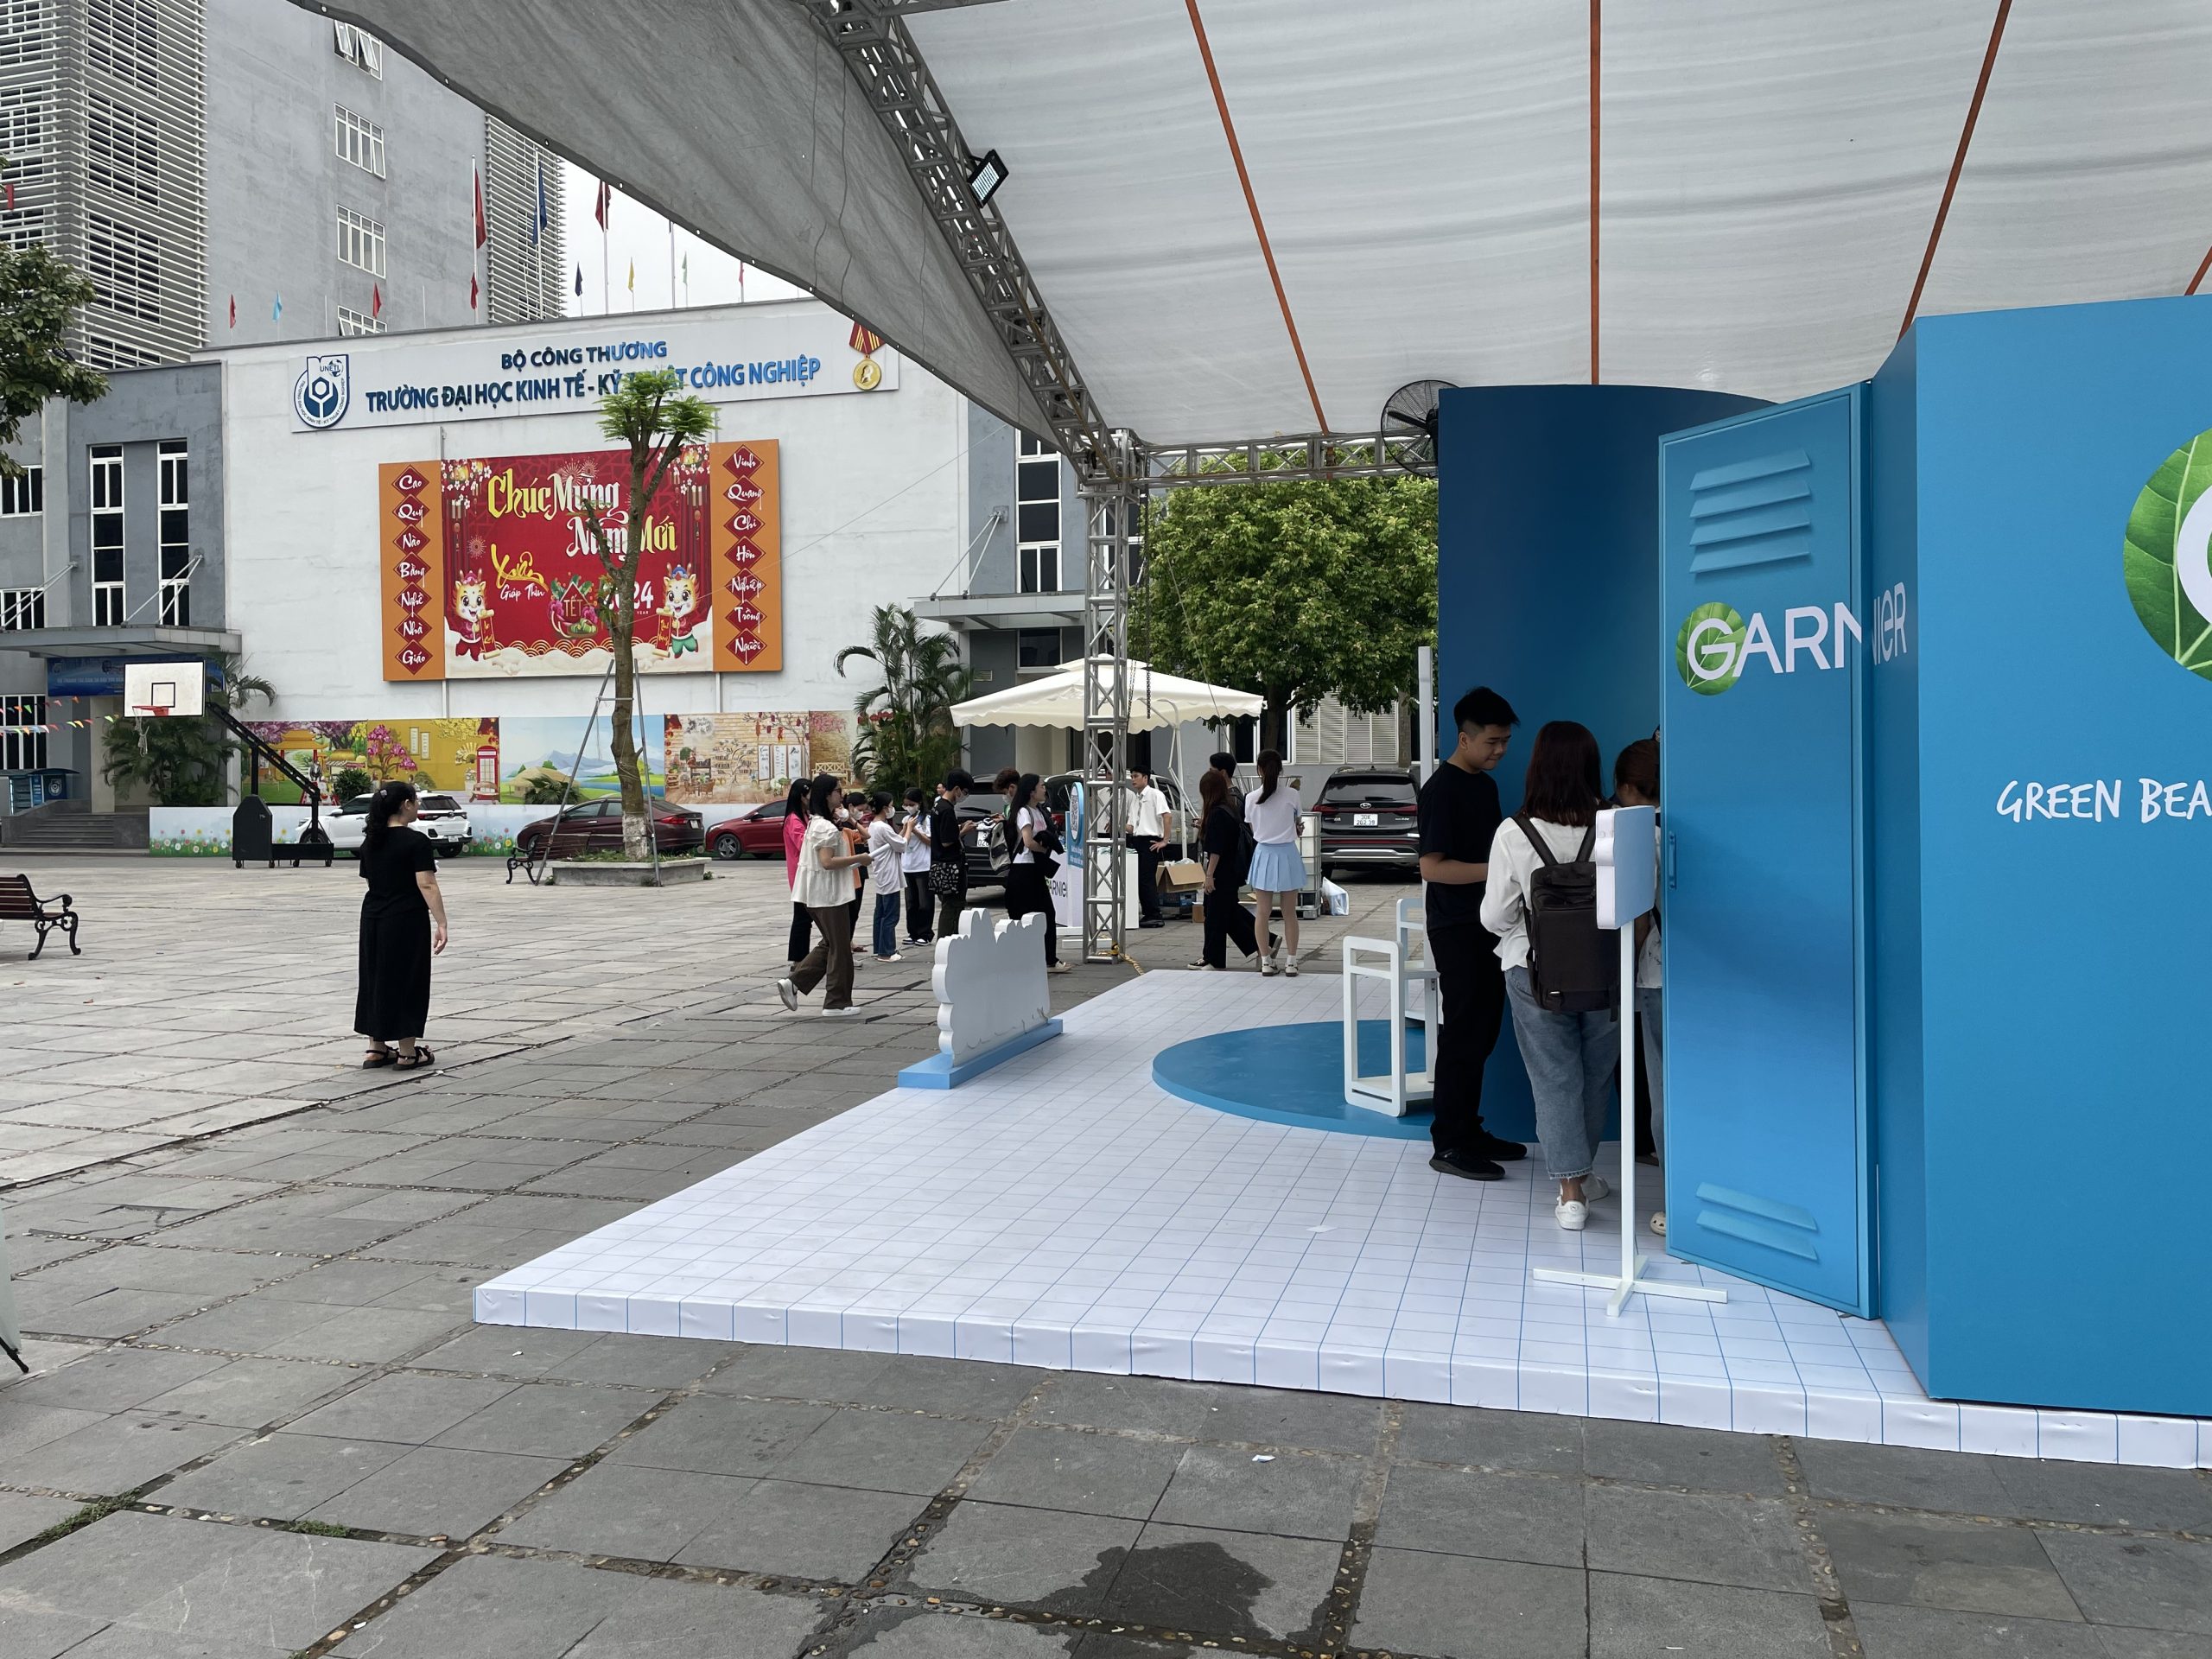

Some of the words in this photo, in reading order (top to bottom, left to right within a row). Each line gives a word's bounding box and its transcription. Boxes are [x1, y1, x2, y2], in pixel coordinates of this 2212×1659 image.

[501, 349, 527, 372] BỘ
[531, 346, 582, 366] CÔNG
[586, 340, 667, 363] THƯƠNG
[365, 385, 438, 411] TRƯỜNG
[442, 385, 473, 411] ĐẠI
[475, 381, 513, 409] HỌC
[516, 378, 560, 401] KINH
[563, 369, 588, 397] TẾ
[598, 369, 623, 396] KỸ
[691, 361, 745, 389] CÔNG
[749, 354, 821, 386] NGHIỆP
[734, 453, 756, 468] Vinh
[399, 474, 422, 490] Cao
[487, 467, 551, 518] Chúc
[728, 484, 761, 511] Quang
[398, 505, 424, 528] Quý
[403, 532, 421, 549] Nào
[563, 594, 583, 617] TẾT
[404, 620, 423, 636] Nhà
[402, 650, 425, 664] Giáo
[1996, 779, 2121, 823] GREEN
